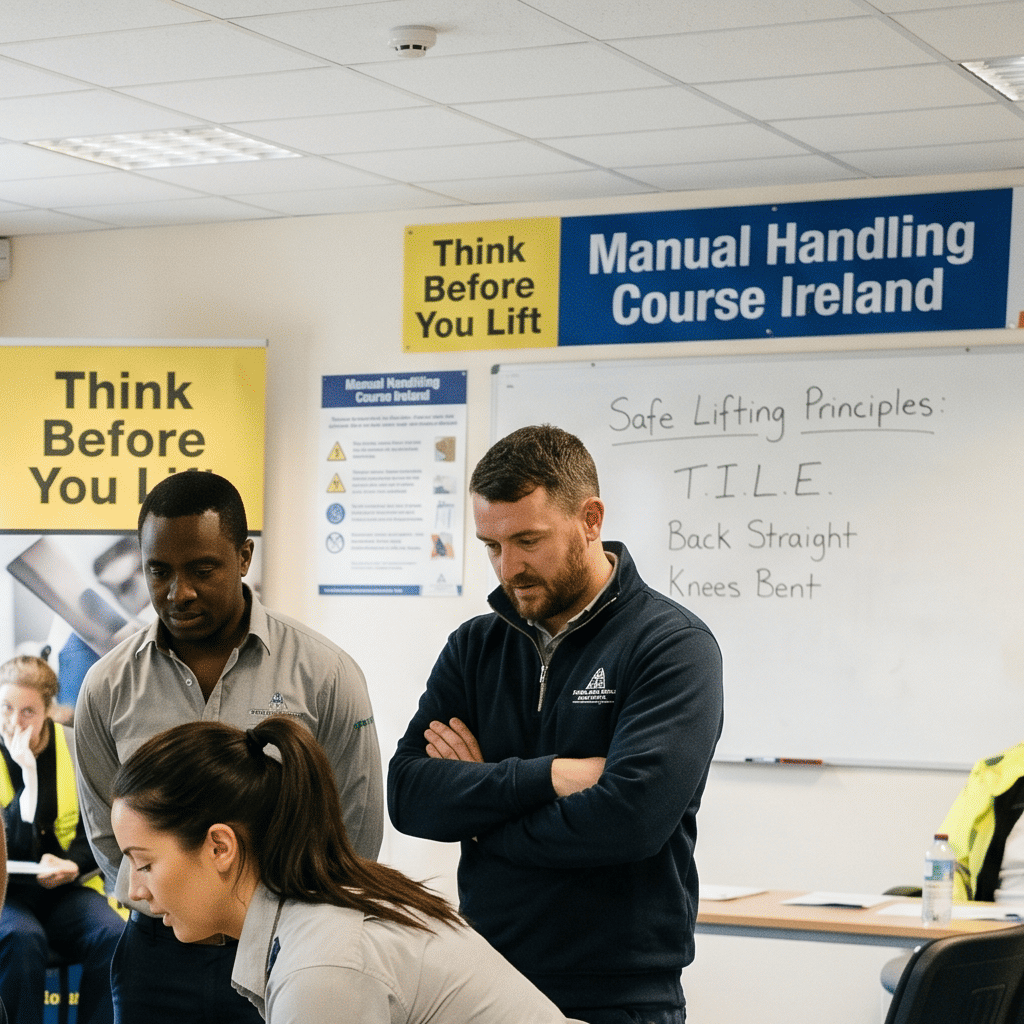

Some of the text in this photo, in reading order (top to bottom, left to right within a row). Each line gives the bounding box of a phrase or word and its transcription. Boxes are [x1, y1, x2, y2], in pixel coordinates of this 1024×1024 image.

[433, 235, 526, 267] Think
[589, 214, 975, 275] Manual Handling
[424, 273, 535, 302] Before
[612, 267, 944, 326] Course Ireland
[415, 307, 541, 338] You Lift
[55, 371, 194, 409] Think
[609, 386, 945, 443] Safe Lifting Principles:
[43, 419, 206, 458] Before
[29, 467, 117, 505] You
[673, 462, 833, 499] T.I.L.E.
[668, 519, 858, 562] Back Straight
[669, 565, 822, 599] Knees Bent
